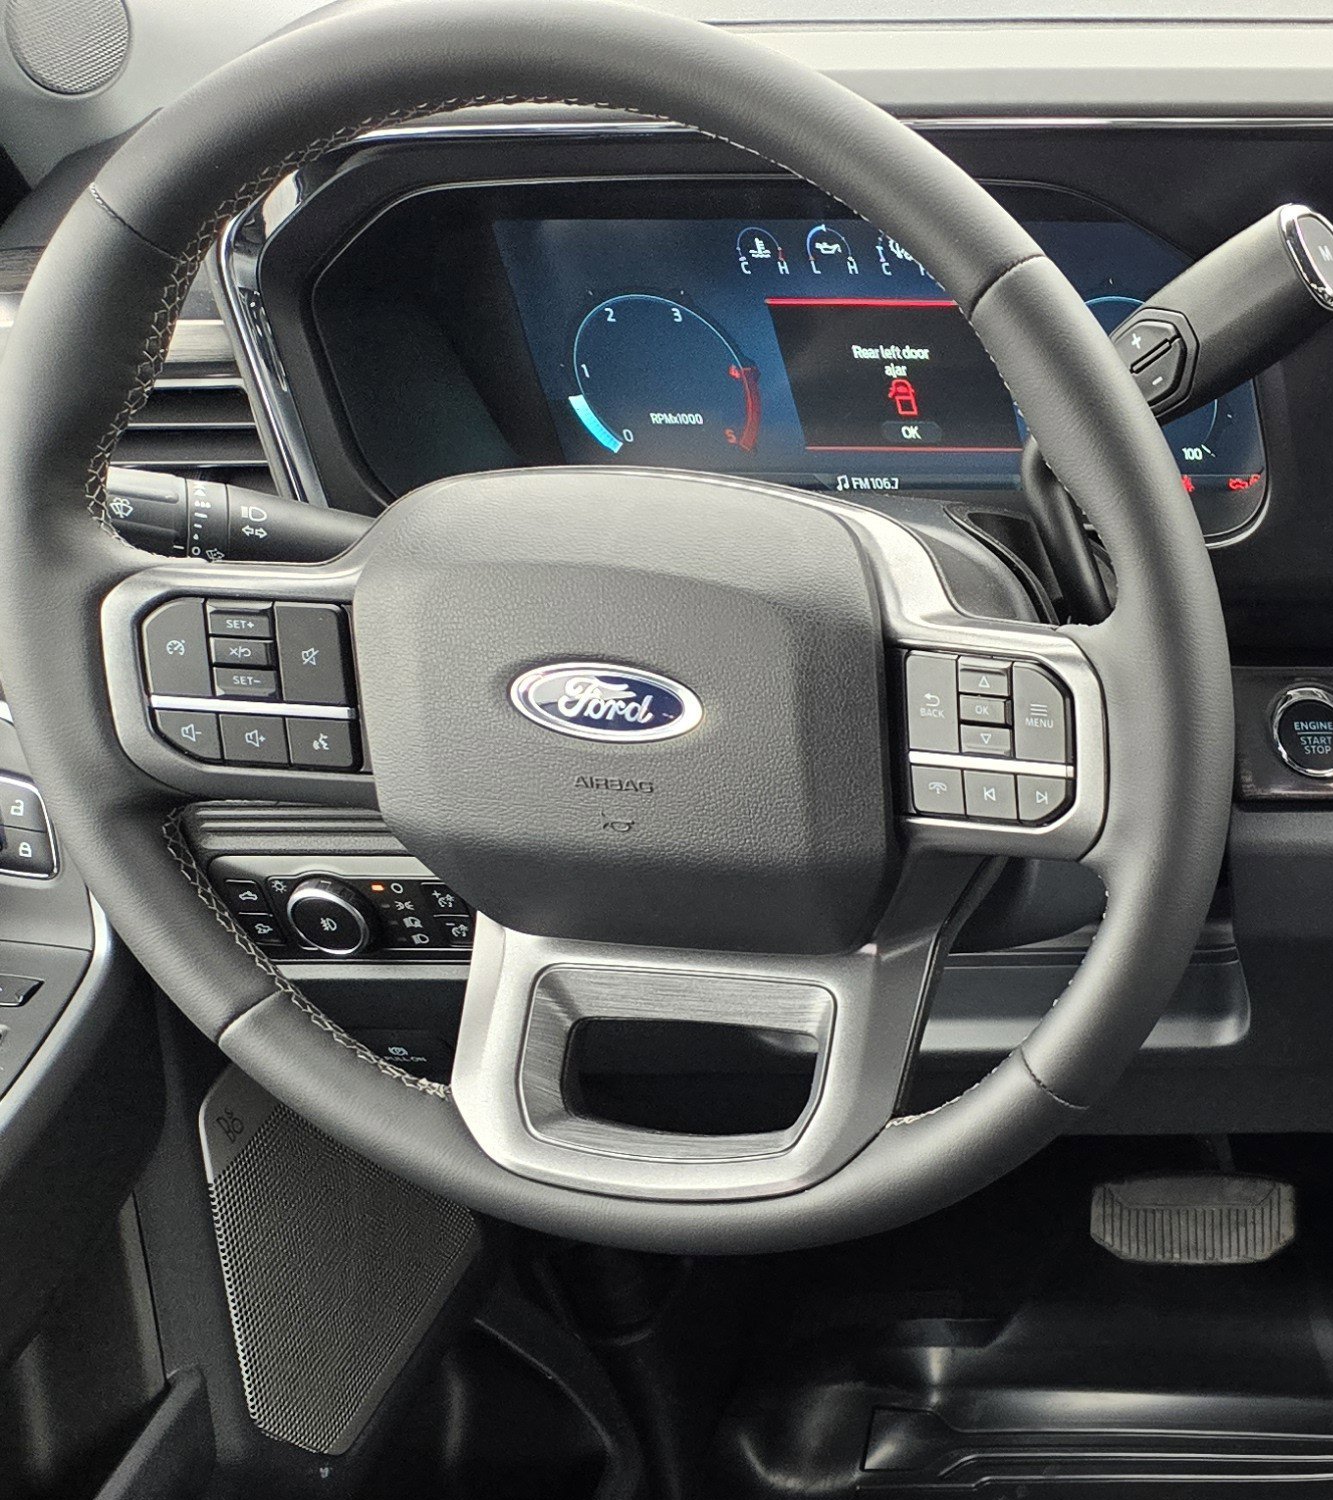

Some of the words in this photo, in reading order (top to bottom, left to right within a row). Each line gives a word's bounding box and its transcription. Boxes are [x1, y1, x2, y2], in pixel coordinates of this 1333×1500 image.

[1317, 245, 1333, 262] M
[604, 307, 616, 323] 2
[672, 307, 683, 323] 3
[851, 344, 879, 359] Rear
[879, 344, 903, 360] left
[902, 344, 930, 360] door
[581, 363, 590, 379] 1
[884, 362, 908, 379] ajar
[622, 428, 634, 443] 0
[901, 425, 922, 440] OK
[1182, 447, 1203, 460] 100
[851, 477, 870, 490] FM
[870, 477, 899, 490] 106.7
[226, 619, 255, 631] SET+
[557, 675, 654, 724] Ford
[919, 708, 945, 720] BACK
[974, 705, 990, 716] OK
[1025, 717, 1055, 730] MENU
[1300, 736, 1333, 746] START
[1304, 745, 1332, 755] STOP
[574, 775, 655, 794] AIRBAG
